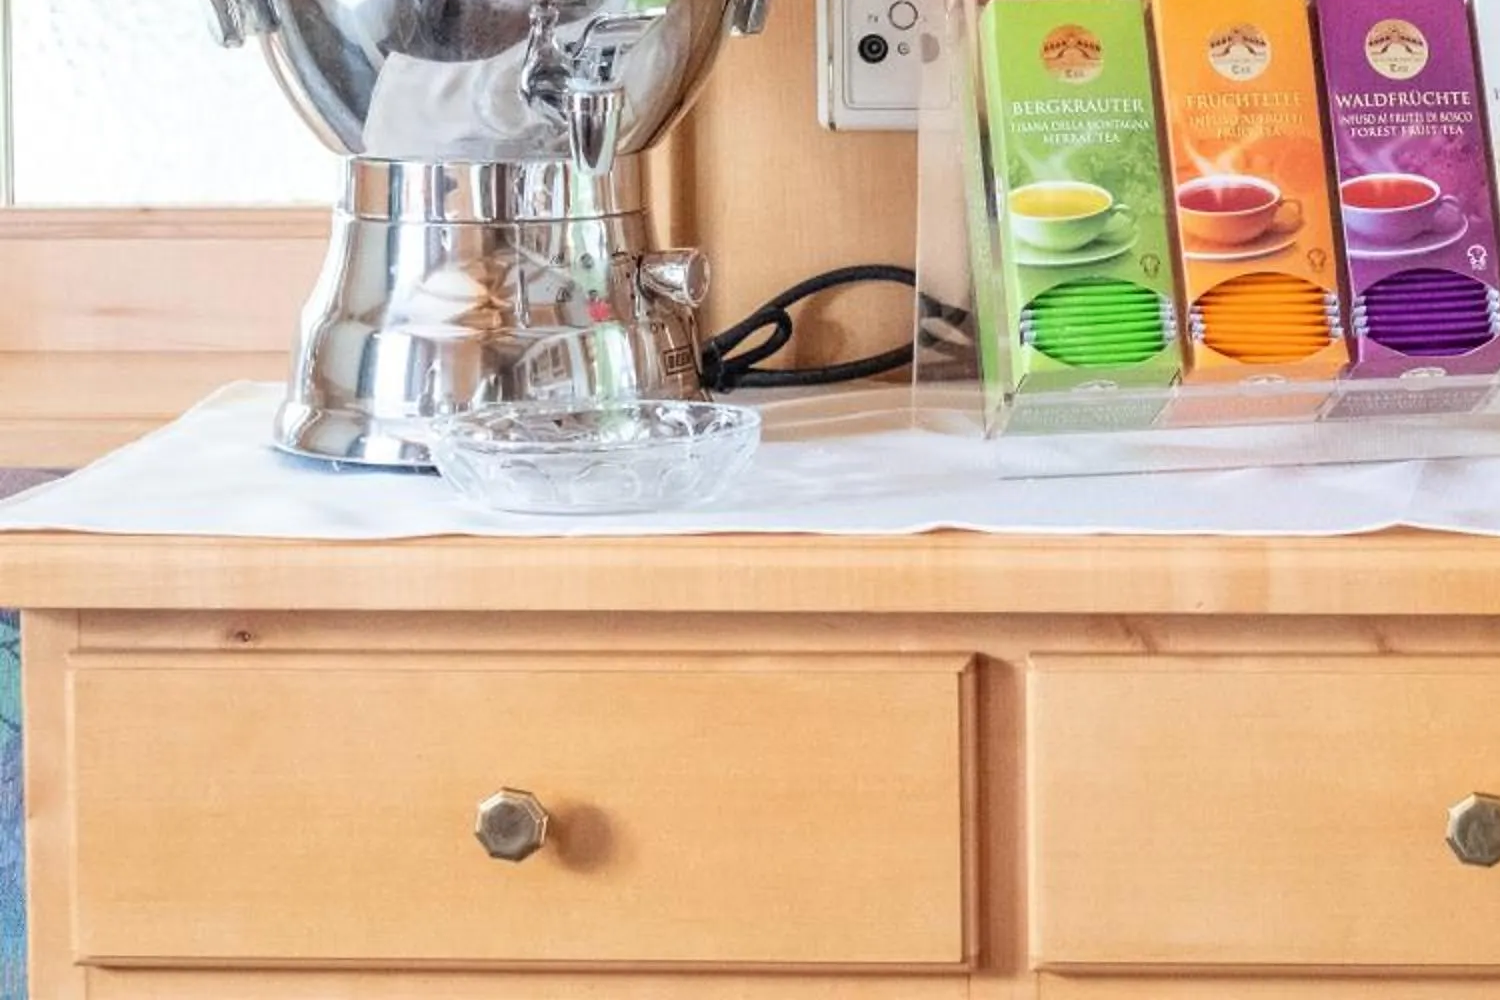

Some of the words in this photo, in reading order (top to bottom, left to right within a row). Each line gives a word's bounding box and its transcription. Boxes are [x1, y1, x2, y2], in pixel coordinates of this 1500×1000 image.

[1350, 125, 1398, 137] FOREST
[1400, 124, 1437, 137] FRUIT
[1442, 124, 1464, 136] TEA
